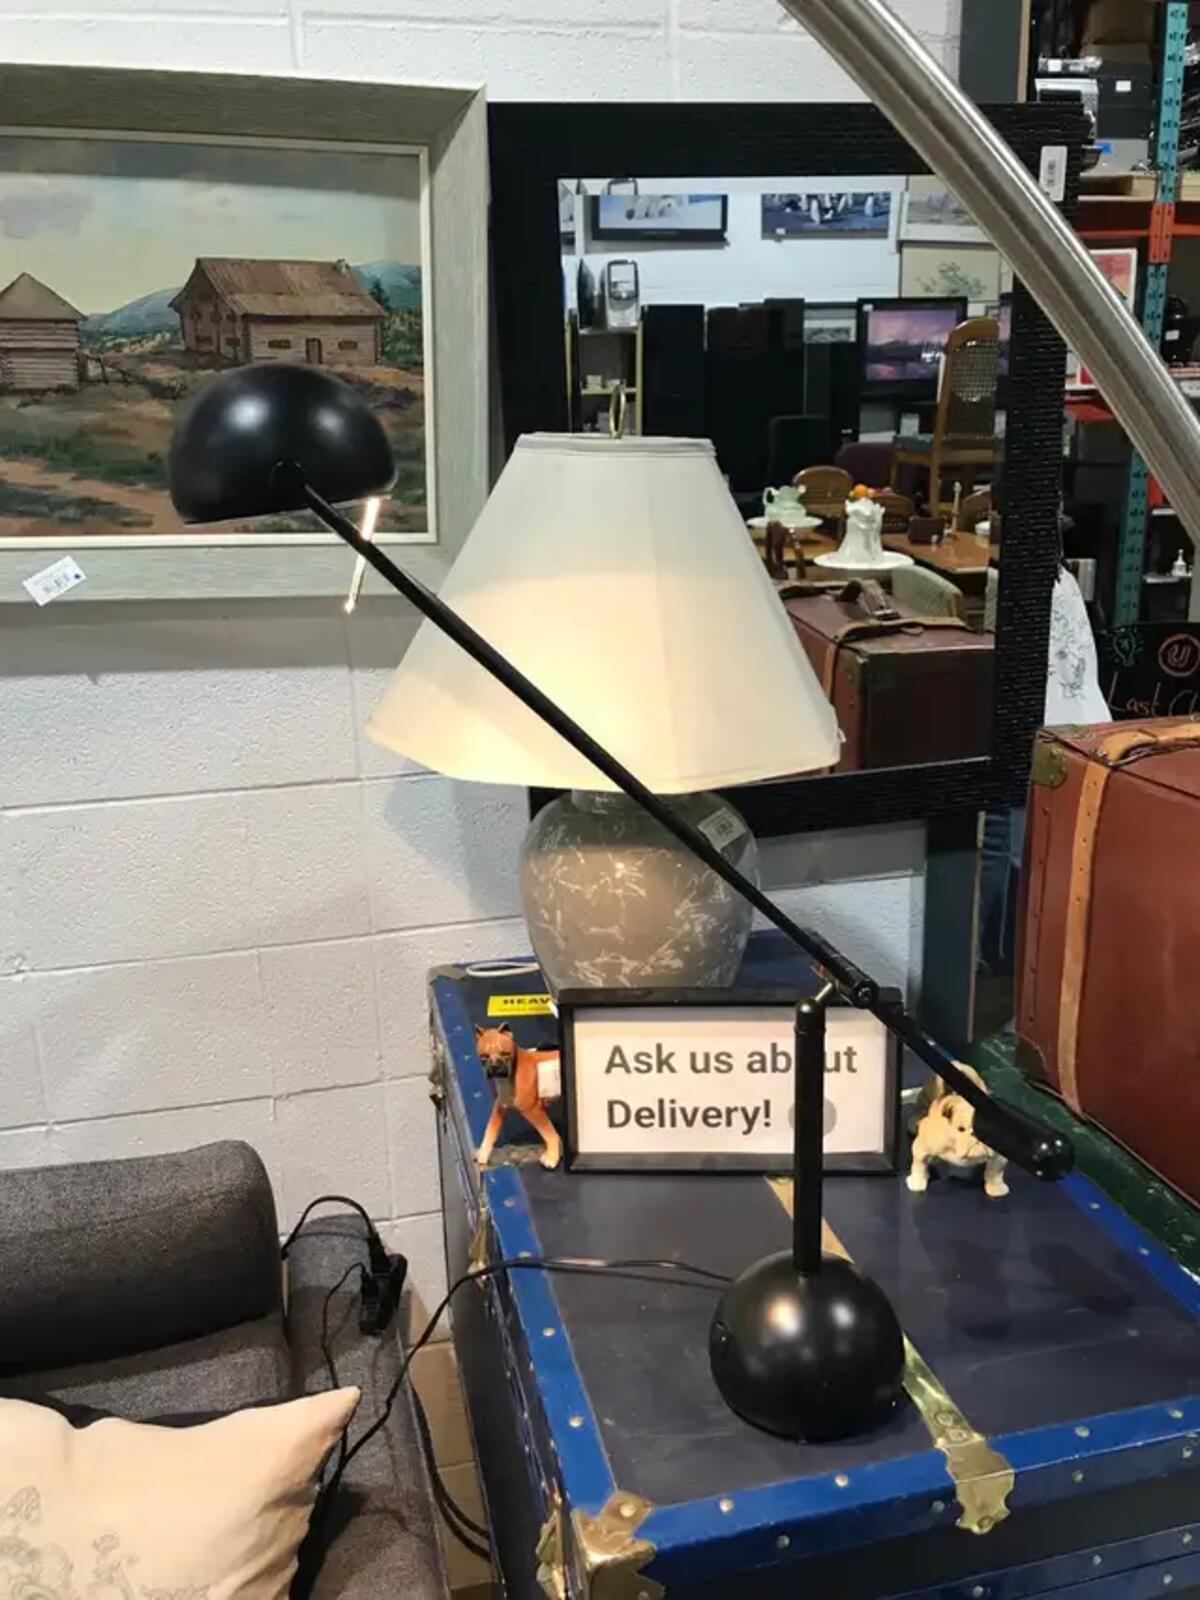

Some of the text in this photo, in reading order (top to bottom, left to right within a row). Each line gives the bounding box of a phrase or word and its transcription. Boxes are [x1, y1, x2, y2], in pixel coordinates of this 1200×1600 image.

[503, 997, 551, 1005] HEAV
[604, 1042, 858, 1075] Ask us abut
[607, 1098, 773, 1135] Delivery!
